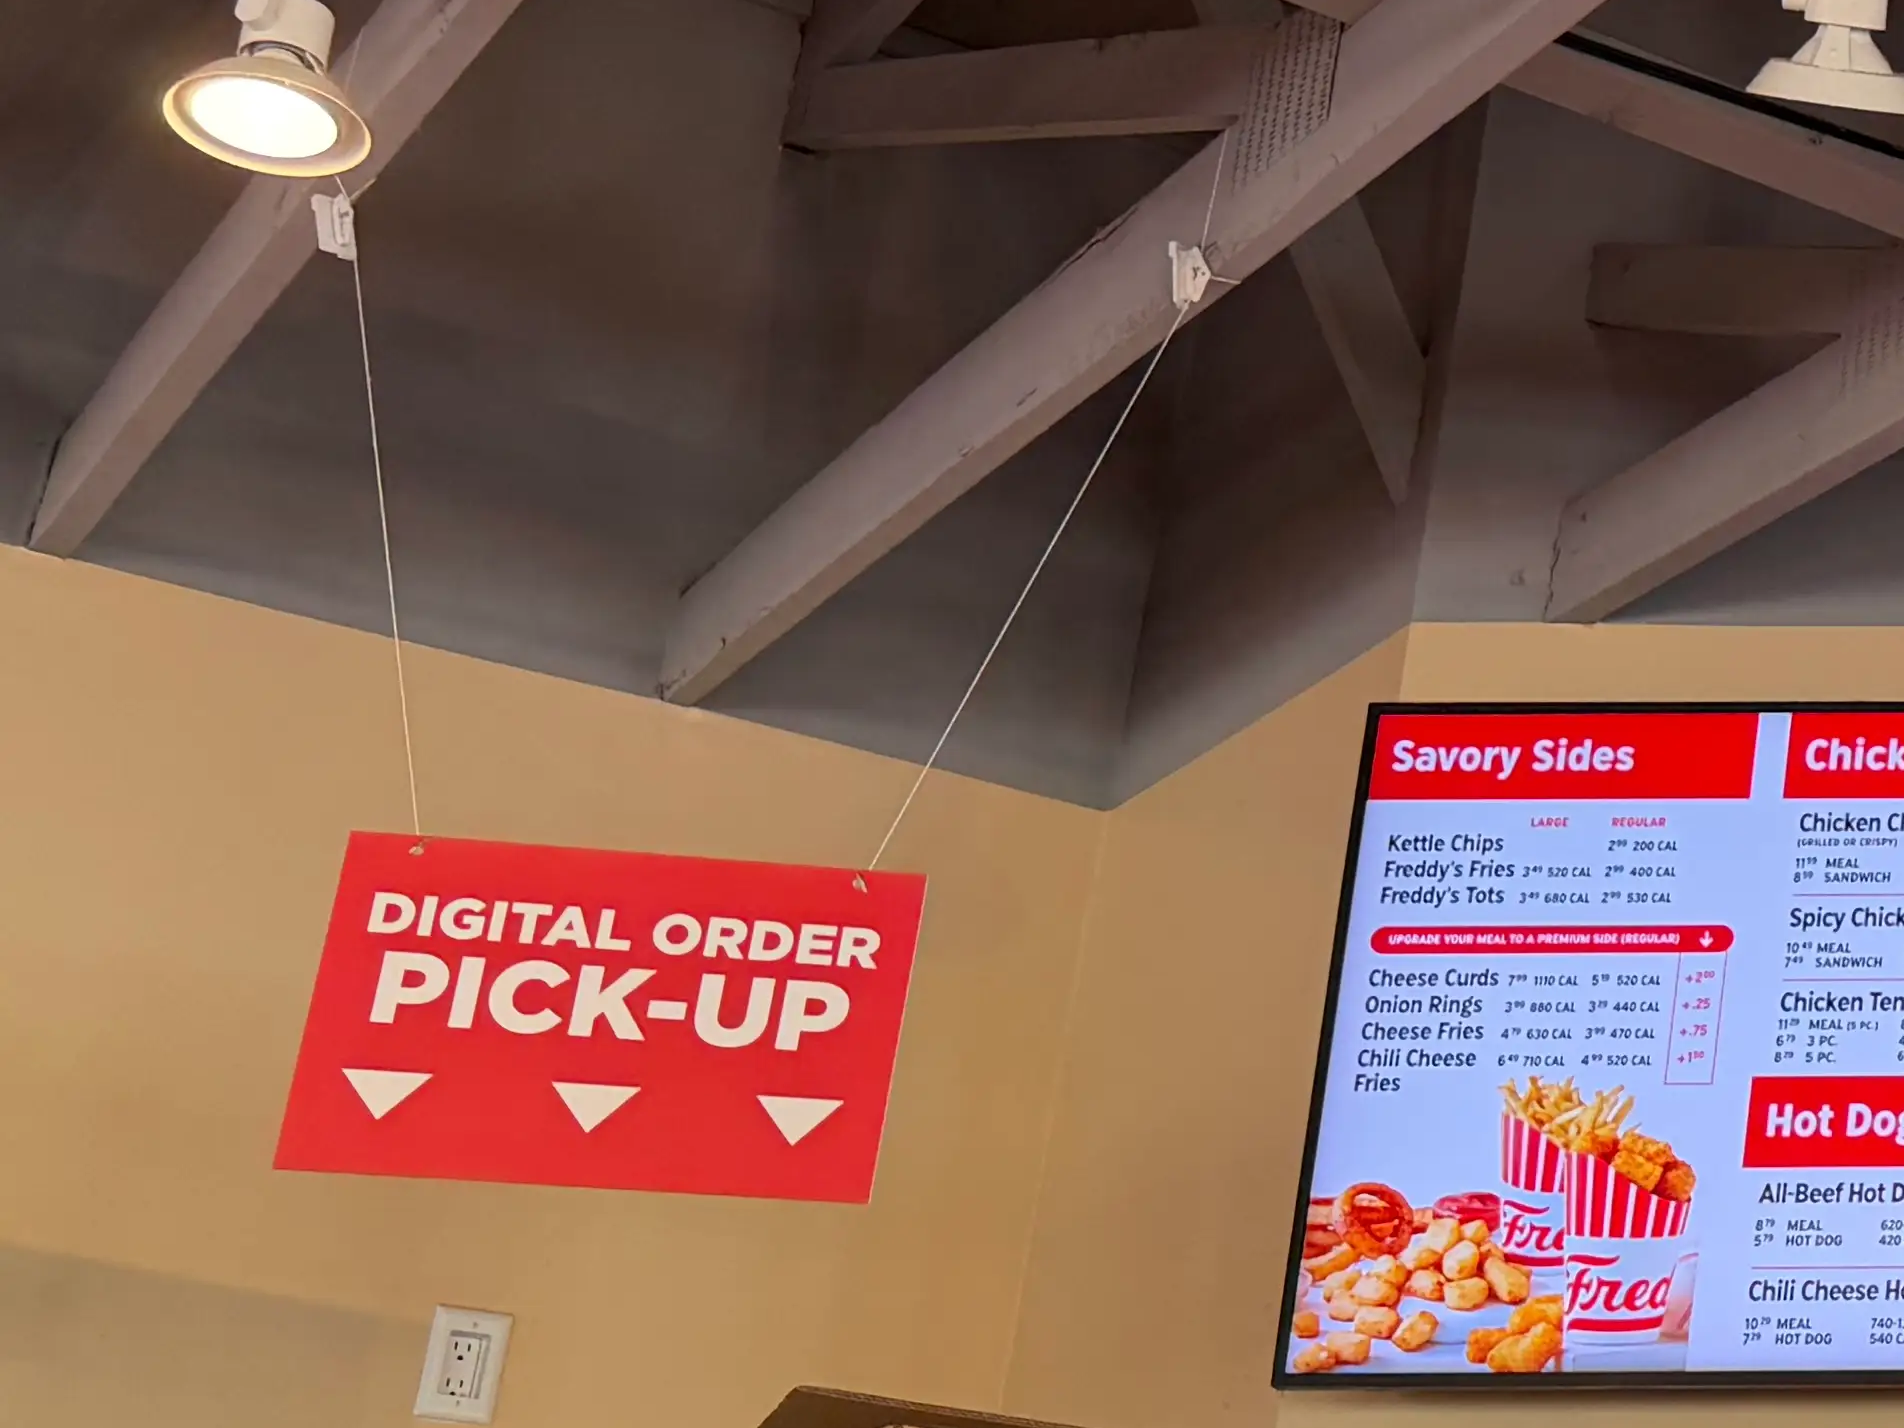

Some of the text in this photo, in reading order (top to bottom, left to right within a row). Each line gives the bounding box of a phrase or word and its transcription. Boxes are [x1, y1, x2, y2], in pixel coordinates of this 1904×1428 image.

[1392, 738, 1634, 780] Savory Sides
[1800, 812, 1880, 832] Chicken
[1388, 834, 1503, 855] Kettle Chips
[1384, 860, 1515, 882] Freddy's Fries
[367, 892, 880, 969] DIGITAL ORDER
[1790, 907, 1845, 932] Spicy
[1816, 957, 1882, 967] SANDWICH
[370, 951, 849, 1050] PICK-UP
[1366, 995, 1482, 1018] Onion Rings
[1767, 1104, 1833, 1136] Hot
[1759, 1183, 1844, 1203] All-Beef
[1849, 1183, 1885, 1202] Hot
